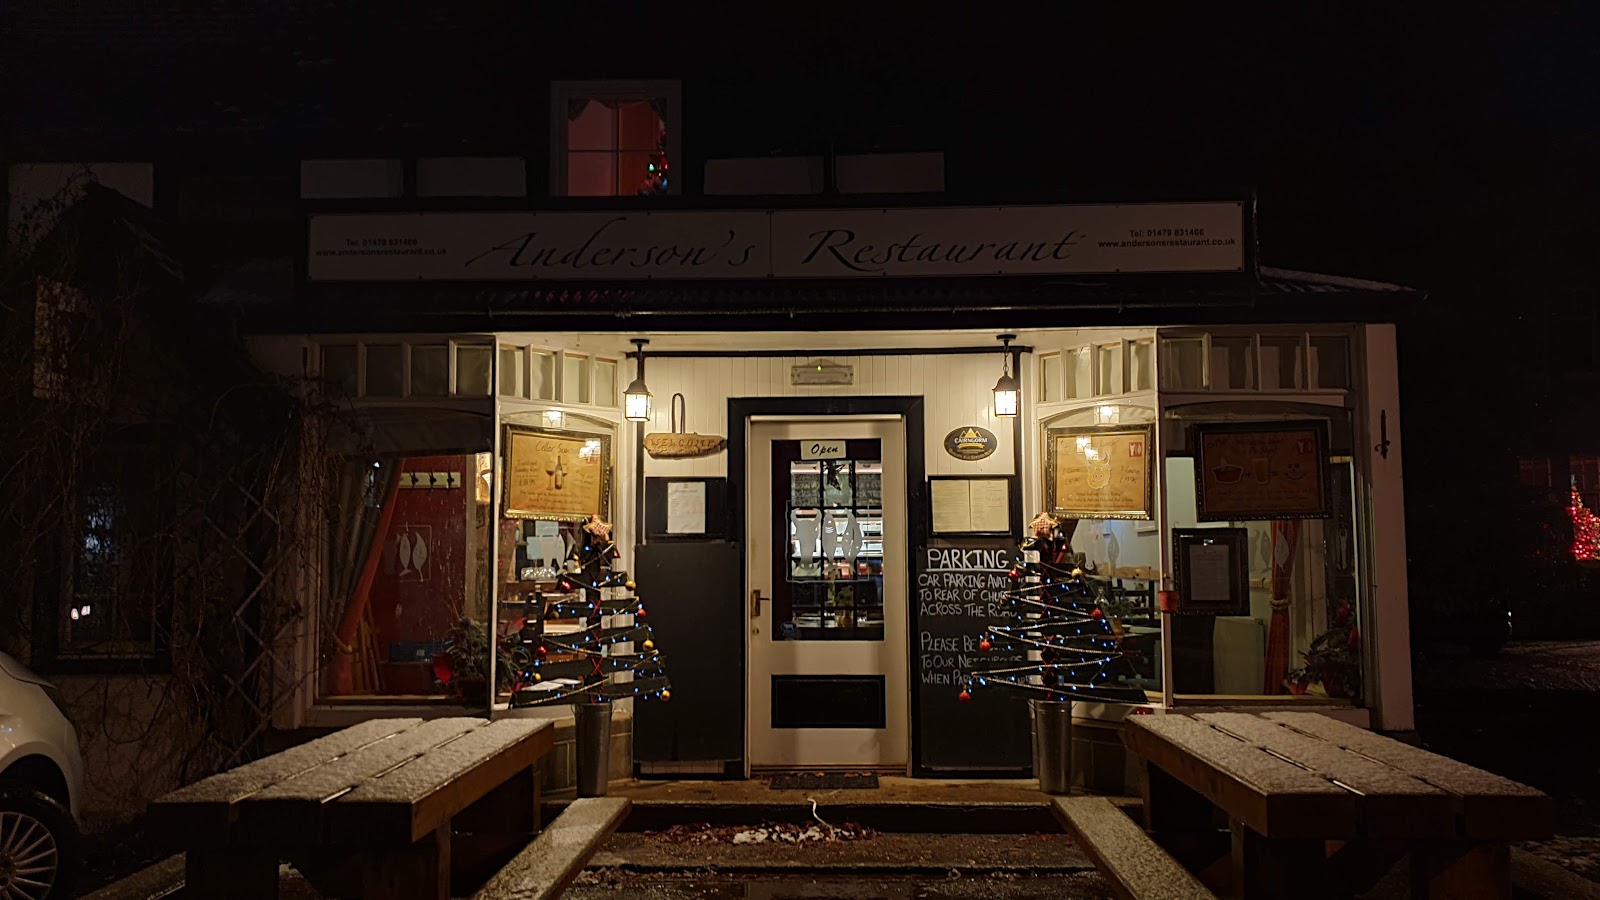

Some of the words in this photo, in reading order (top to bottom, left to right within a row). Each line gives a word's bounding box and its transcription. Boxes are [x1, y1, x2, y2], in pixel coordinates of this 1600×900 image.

[1129, 229, 1144, 237] Tel:
[1175, 228, 1204, 236] 831466
[465, 216, 755, 268] Anderson's
[801, 229, 1086, 272] Restaurant
[1098, 238, 1236, 247] www.andersonsrestaurant.co.uk
[811, 443, 838, 456] Open
[927, 548, 1009, 569] PARKING
[918, 573, 940, 587] CAR
[944, 572, 985, 589] PARKING
[919, 588, 932, 600] TO
[934, 588, 961, 602] REAR
[963, 588, 978, 601] OF
[920, 602, 962, 617] ACROSS
[964, 602, 985, 617] THE
[920, 631, 959, 652] PLEASE
[963, 635, 976, 653] BE
[921, 670, 950, 685] WHEN
